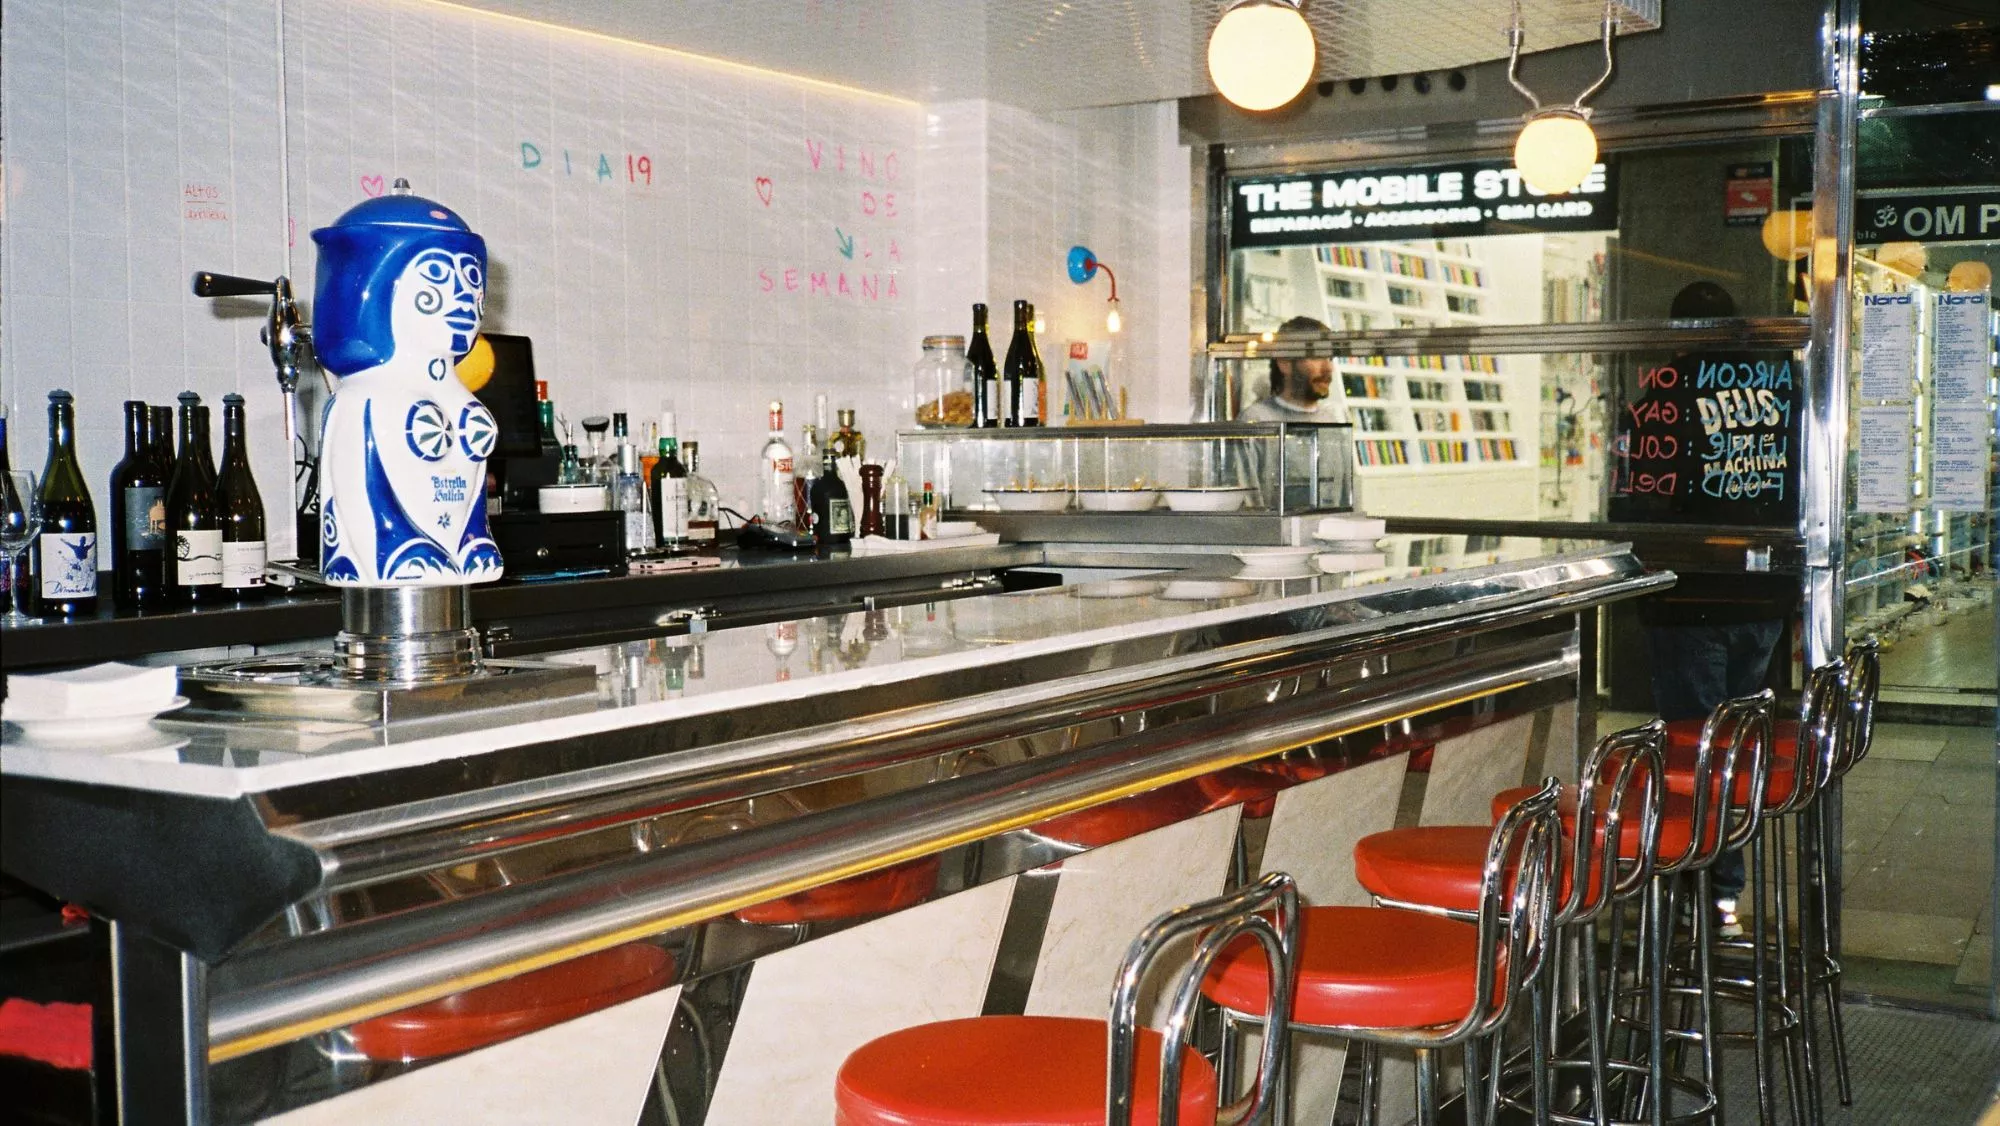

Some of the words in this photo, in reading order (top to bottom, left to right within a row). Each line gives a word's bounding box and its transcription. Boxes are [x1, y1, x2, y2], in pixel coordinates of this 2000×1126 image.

[627, 154, 651, 185] 19
[1239, 181, 1313, 213] THE
[1322, 173, 1463, 209] MOBILE
[1474, 163, 1606, 200] STE
[862, 191, 896, 217] DE
[1536, 200, 1593, 218] CARD
[1903, 205, 1965, 237] OM
[758, 267, 898, 300] SEMANA
[1864, 294, 1912, 306] Nardi
[1939, 294, 1985, 306] Nardi
[1696, 387, 1780, 436] DEUS
